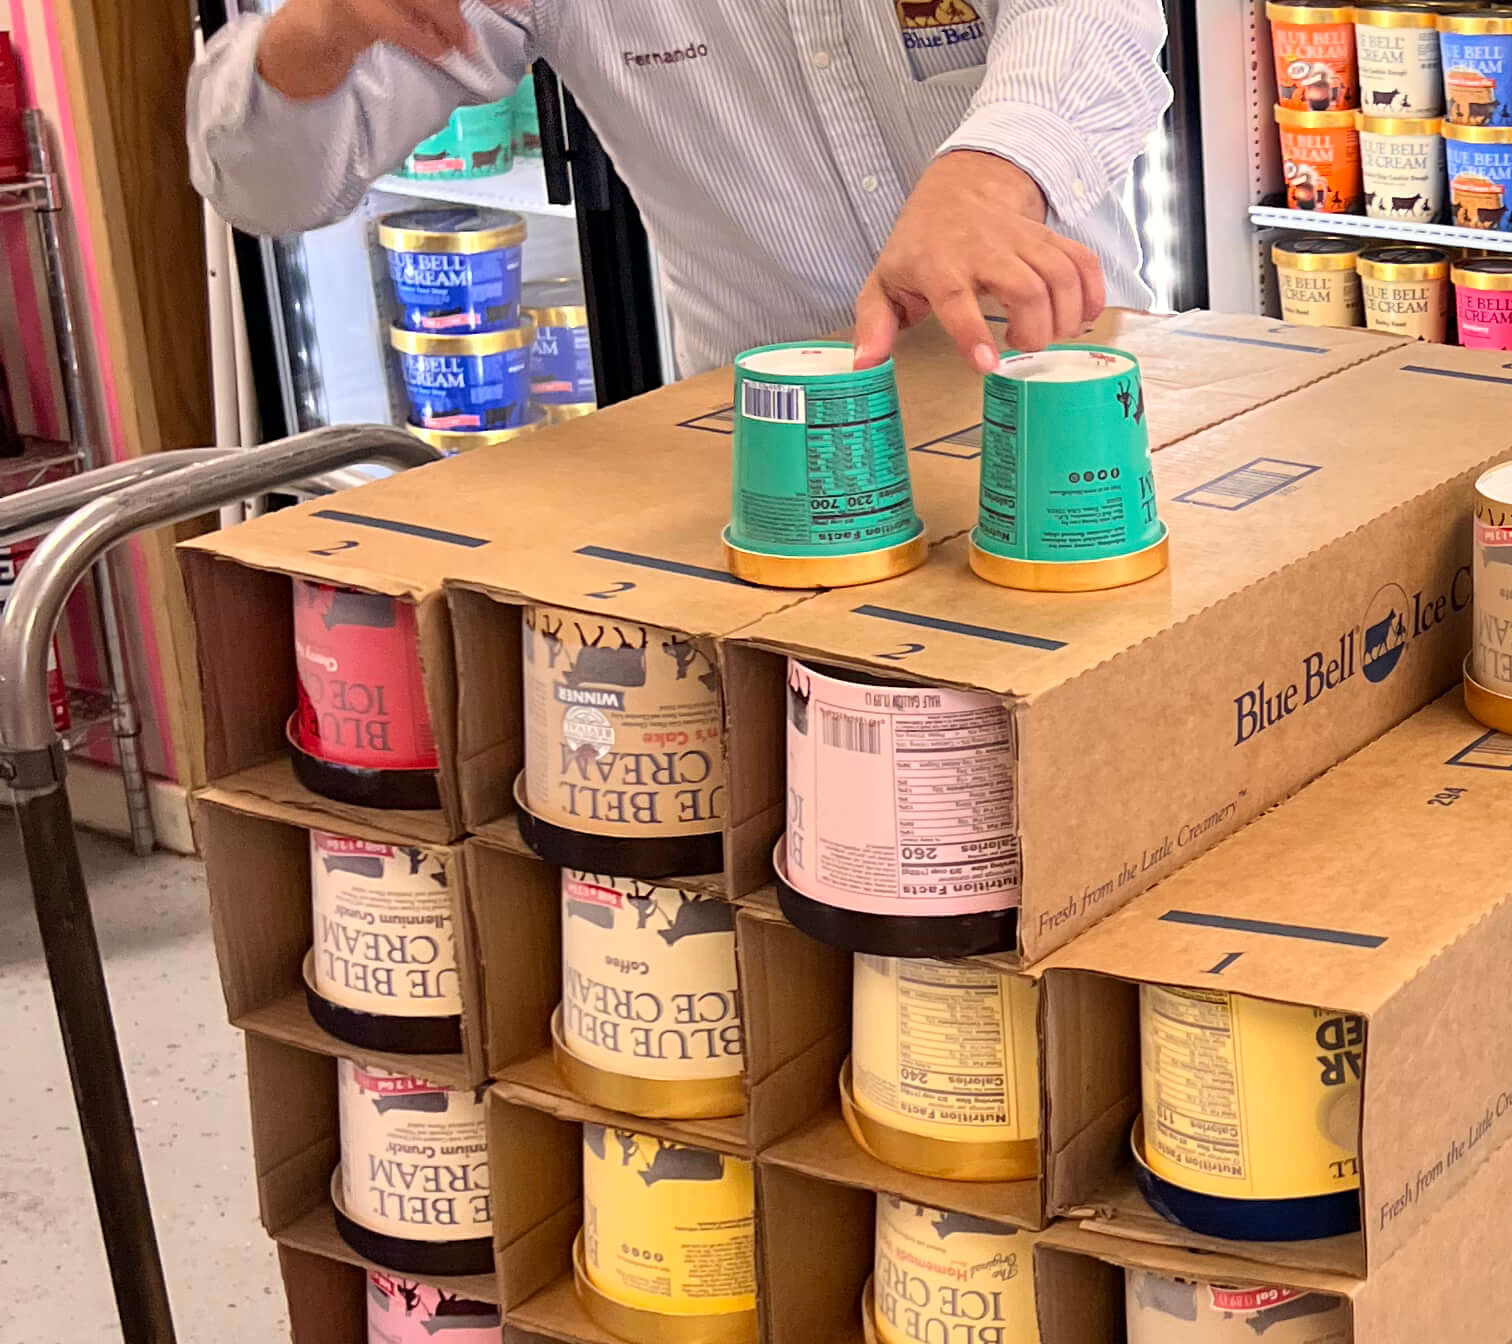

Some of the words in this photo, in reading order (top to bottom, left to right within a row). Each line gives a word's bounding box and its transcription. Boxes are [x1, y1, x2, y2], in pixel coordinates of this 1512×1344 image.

[901, 28, 943, 52] Blue
[944, 23, 984, 47] Bell
[623, 42, 709, 69] Fernando
[1295, 278, 1331, 289] BELL
[1392, 287, 1429, 300] BELL
[1377, 300, 1429, 313] CREAM
[311, 540, 360, 556] 2
[586, 580, 636, 599] 2
[1232, 681, 1299, 749] Blue
[1302, 628, 1361, 705] Bell
[1411, 587, 1449, 637] Ice
[328, 681, 386, 716] ICE
[558, 686, 620, 708] WINNER
[642, 731, 688, 746] Cake
[558, 742, 712, 785] CREAM
[559, 781, 661, 825] BELL
[1427, 784, 1466, 807] 294
[901, 847, 937, 860] 260
[1038, 895, 1077, 936] Fresh
[1080, 879, 1113, 915] from
[1117, 862, 1138, 887] the
[1141, 836, 1174, 873] Little
[1177, 800, 1238, 848] Creamery
[903, 885, 948, 896] Facts
[322, 914, 439, 965] CREAM
[323, 948, 398, 997] BELL
[603, 954, 650, 974] Coffee
[900, 1067, 929, 1084] 240
[949, 1072, 1005, 1087] Calories
[900, 1101, 943, 1119] Facts
[948, 1106, 1007, 1125] Nutrition
[1379, 1182, 1412, 1232] Fresh
[1414, 1159, 1444, 1204] from
[1446, 1140, 1465, 1168] the
[1468, 1108, 1494, 1150] Little
[370, 1186, 461, 1226] BELL
[937, 1286, 1006, 1322] ICE
